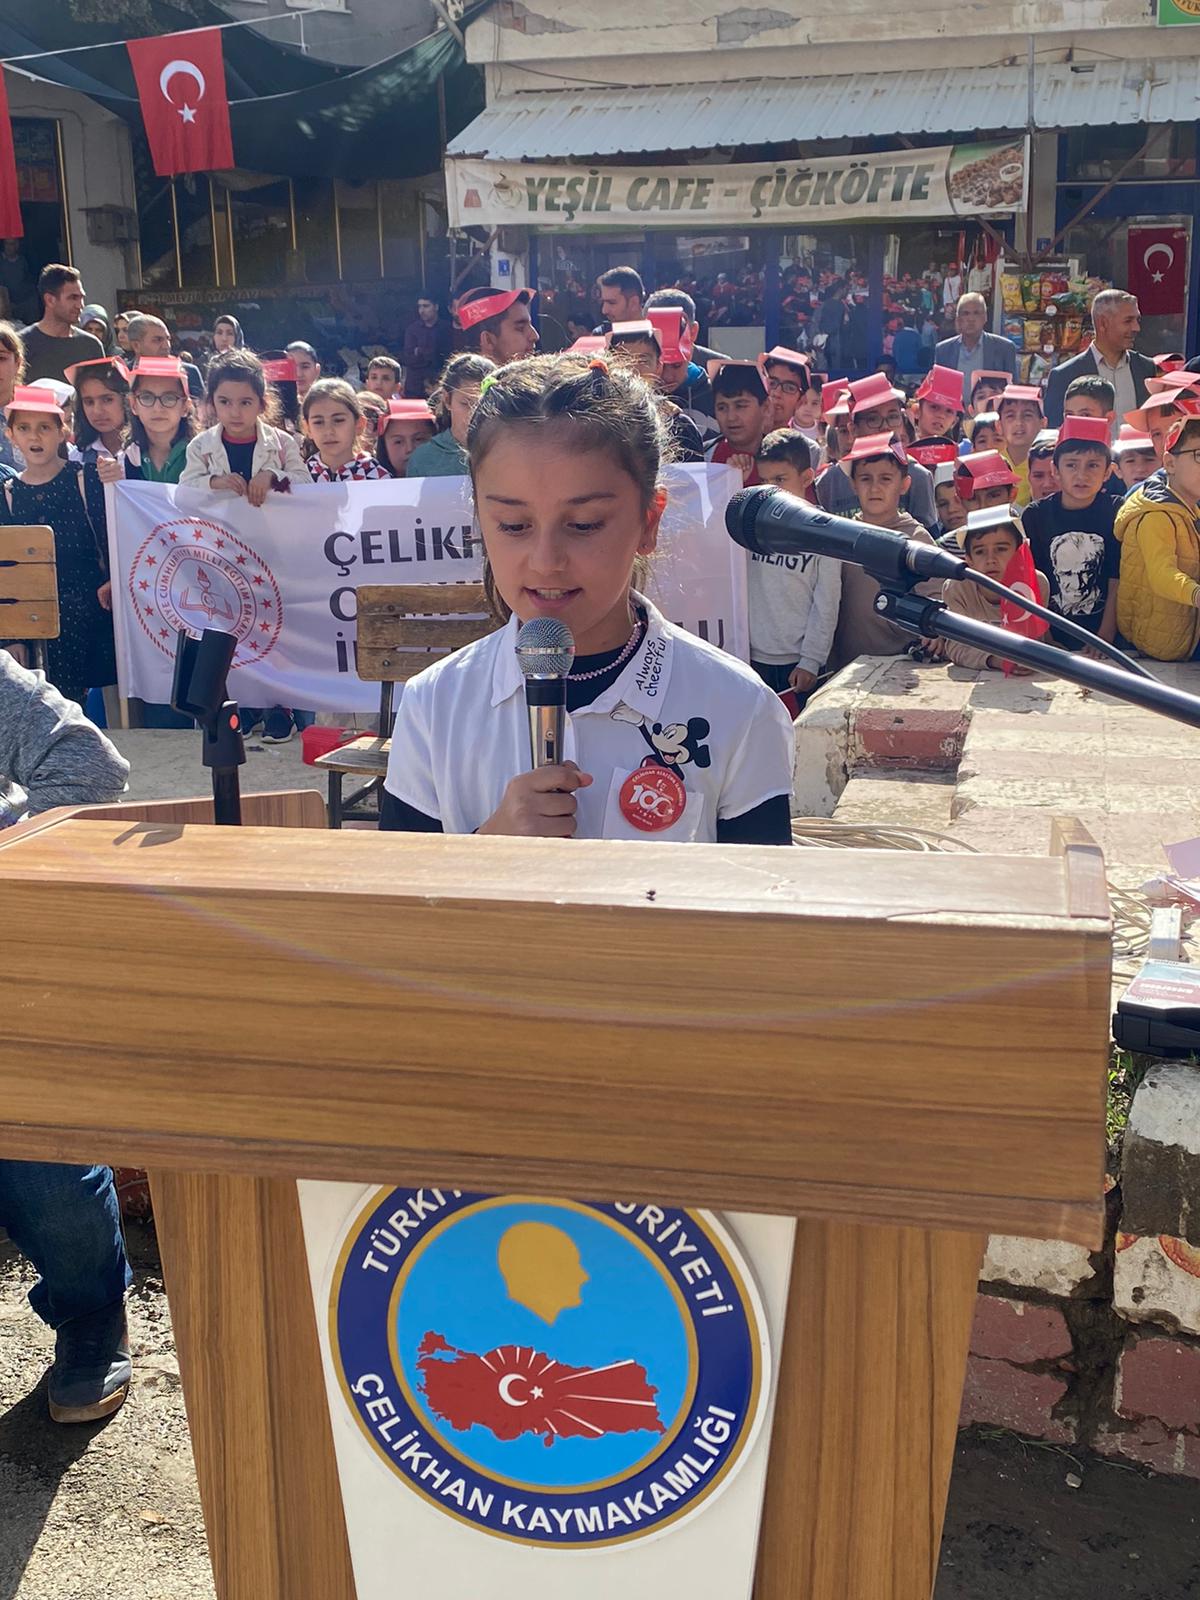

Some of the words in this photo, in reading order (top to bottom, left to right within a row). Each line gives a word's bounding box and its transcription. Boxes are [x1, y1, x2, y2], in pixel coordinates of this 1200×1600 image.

[525, 169, 611, 222] YEŞİL
[626, 177, 714, 212] CAFE
[750, 161, 934, 218] ÇİĞKÖFTE
[323, 518, 483, 577] ÇELİKH
[635, 640, 656, 691] Always
[644, 637, 667, 697] cheerful
[362, 1187, 462, 1273] TÜRKİ
[614, 1200, 734, 1317] RİYETİ
[351, 1373, 494, 1517] ÇELİKHAN
[502, 1405, 737, 1534] KAYMAKAMLIĞI
